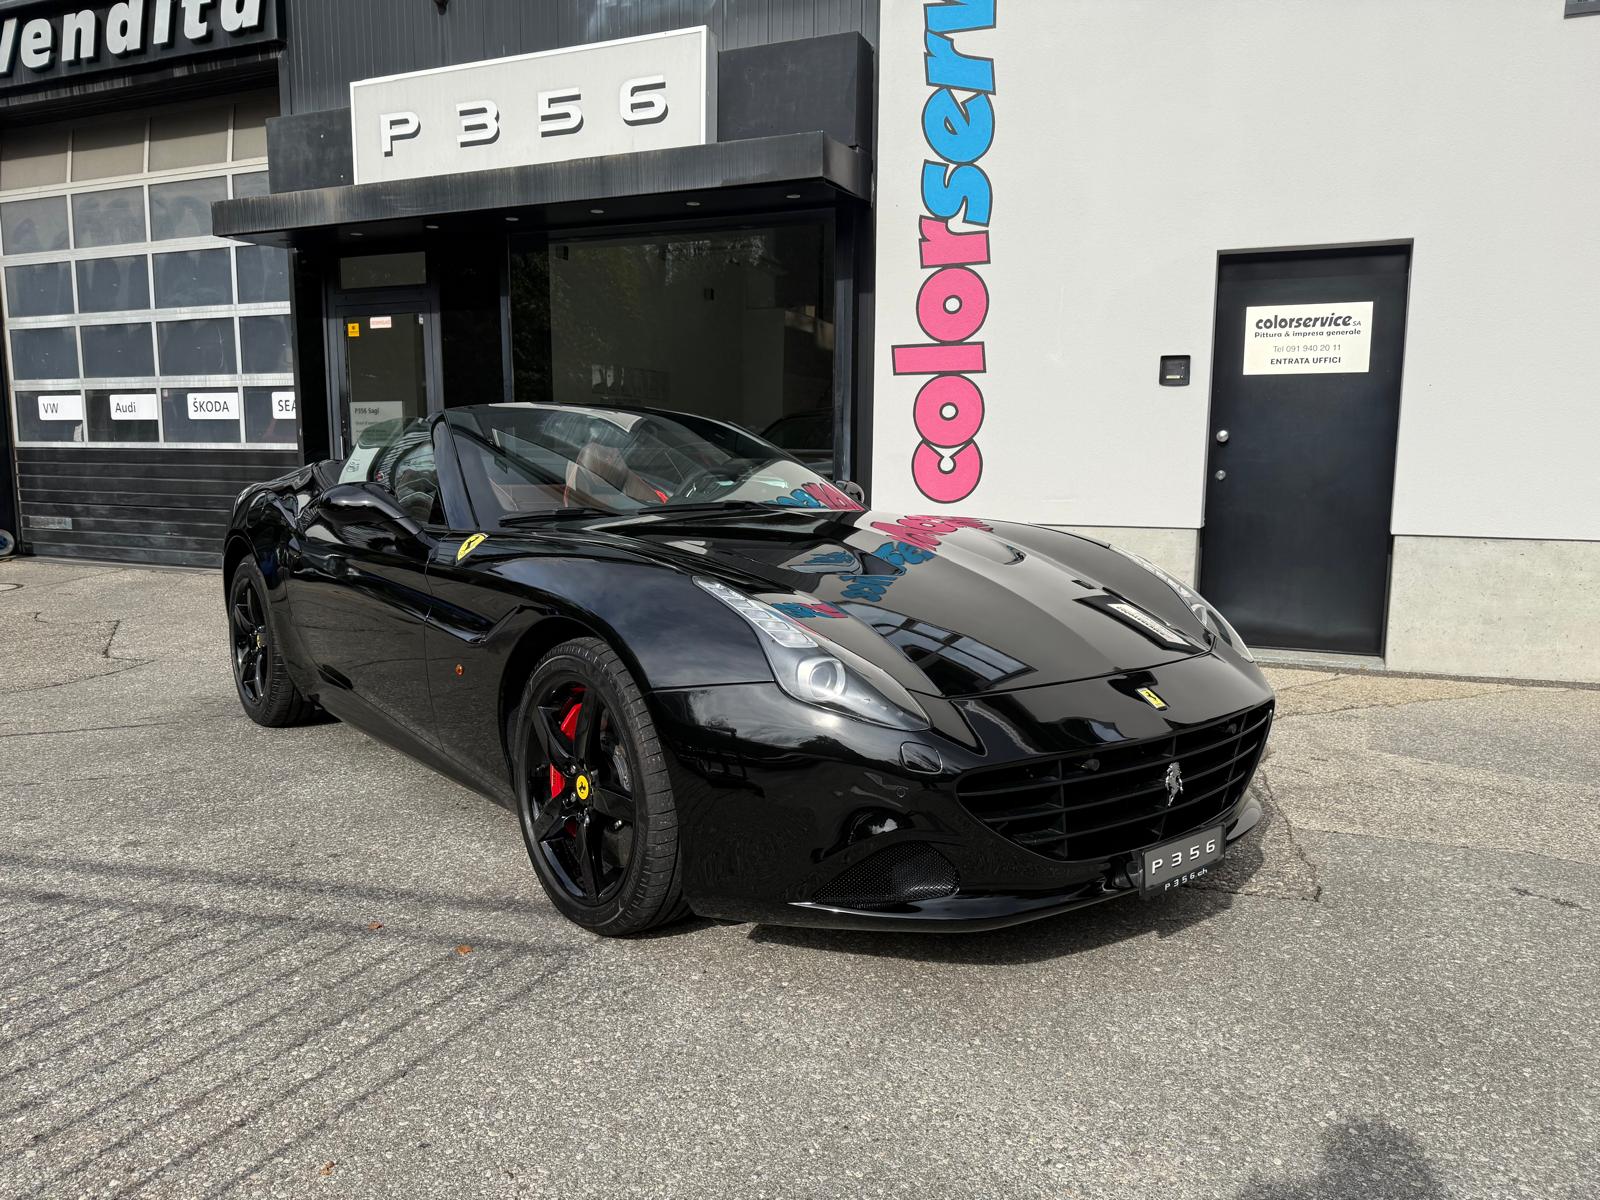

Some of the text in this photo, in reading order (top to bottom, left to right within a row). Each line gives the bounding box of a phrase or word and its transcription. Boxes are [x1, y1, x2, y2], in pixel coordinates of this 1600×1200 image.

[1255, 312, 1353, 330] colorservice
[1292, 330, 1324, 338] impresa
[1326, 328, 1361, 337] generale
[1273, 345, 1284, 353] Tel
[1302, 344, 1318, 352] 940
[1320, 344, 1330, 352] 20
[1270, 356, 1341, 365] ENTRATA UFFICI
[42, 402, 59, 414] VW
[115, 402, 136, 413] Audi
[193, 397, 230, 413] ŠKODA
